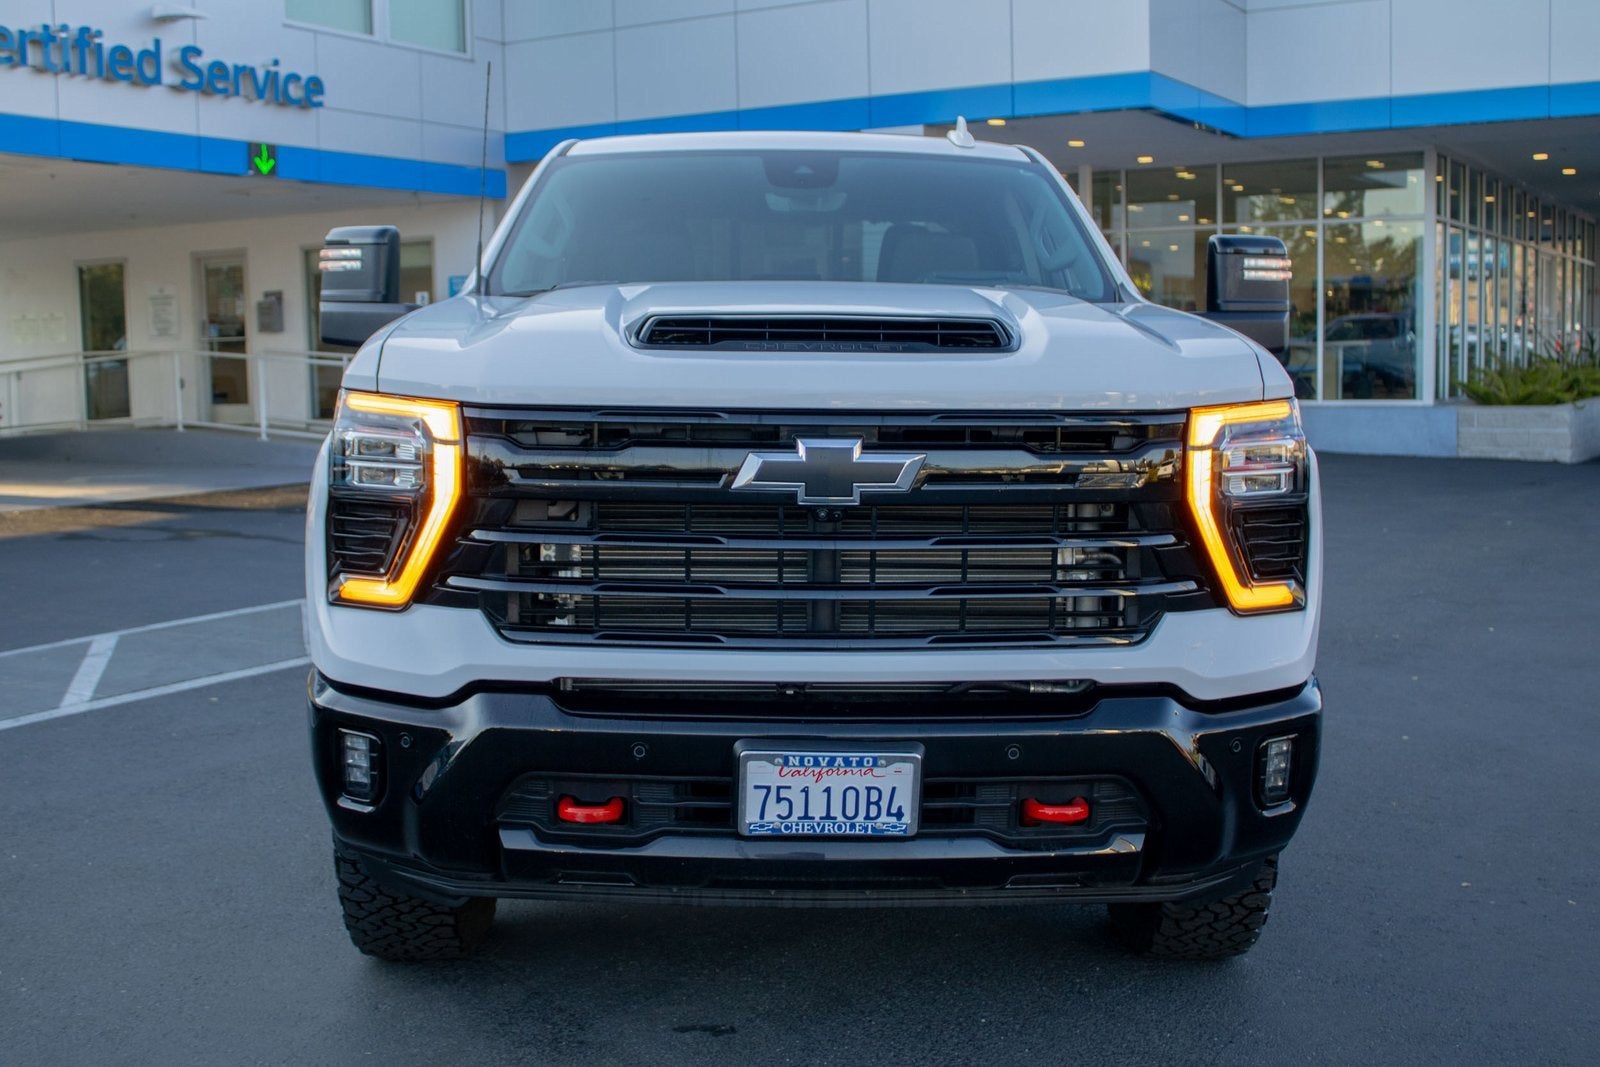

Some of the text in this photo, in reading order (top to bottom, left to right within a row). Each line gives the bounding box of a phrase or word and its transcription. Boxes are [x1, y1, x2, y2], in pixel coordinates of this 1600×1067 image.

[180, 44, 325, 108] Service
[743, 341, 909, 351] CHEVROLET
[788, 756, 873, 767] NOVATO
[778, 766, 886, 783] California
[753, 784, 905, 821] 75110B4
[780, 822, 875, 834] CHEVROLET
